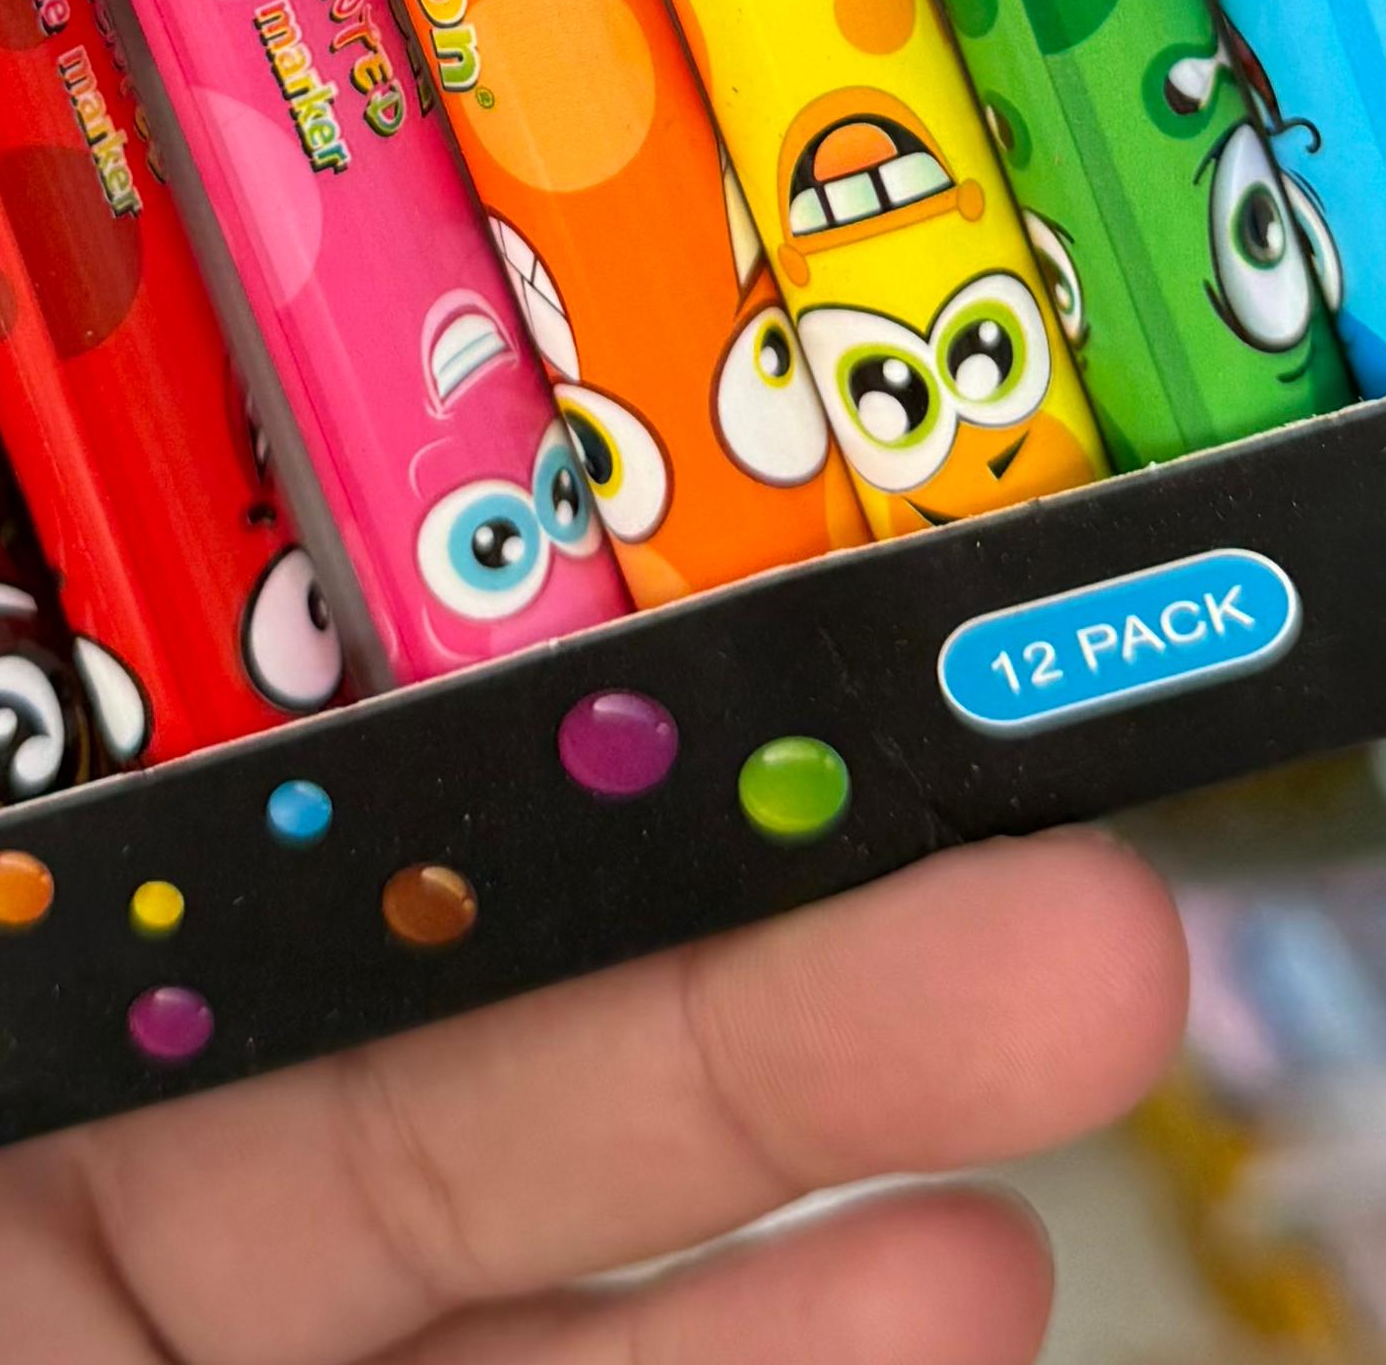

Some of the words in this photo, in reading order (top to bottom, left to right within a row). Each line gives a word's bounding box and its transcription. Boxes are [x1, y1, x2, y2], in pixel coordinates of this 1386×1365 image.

[58, 44, 143, 219] marker
[990, 640, 1064, 695] 12
[1076, 584, 1256, 673] PACK
